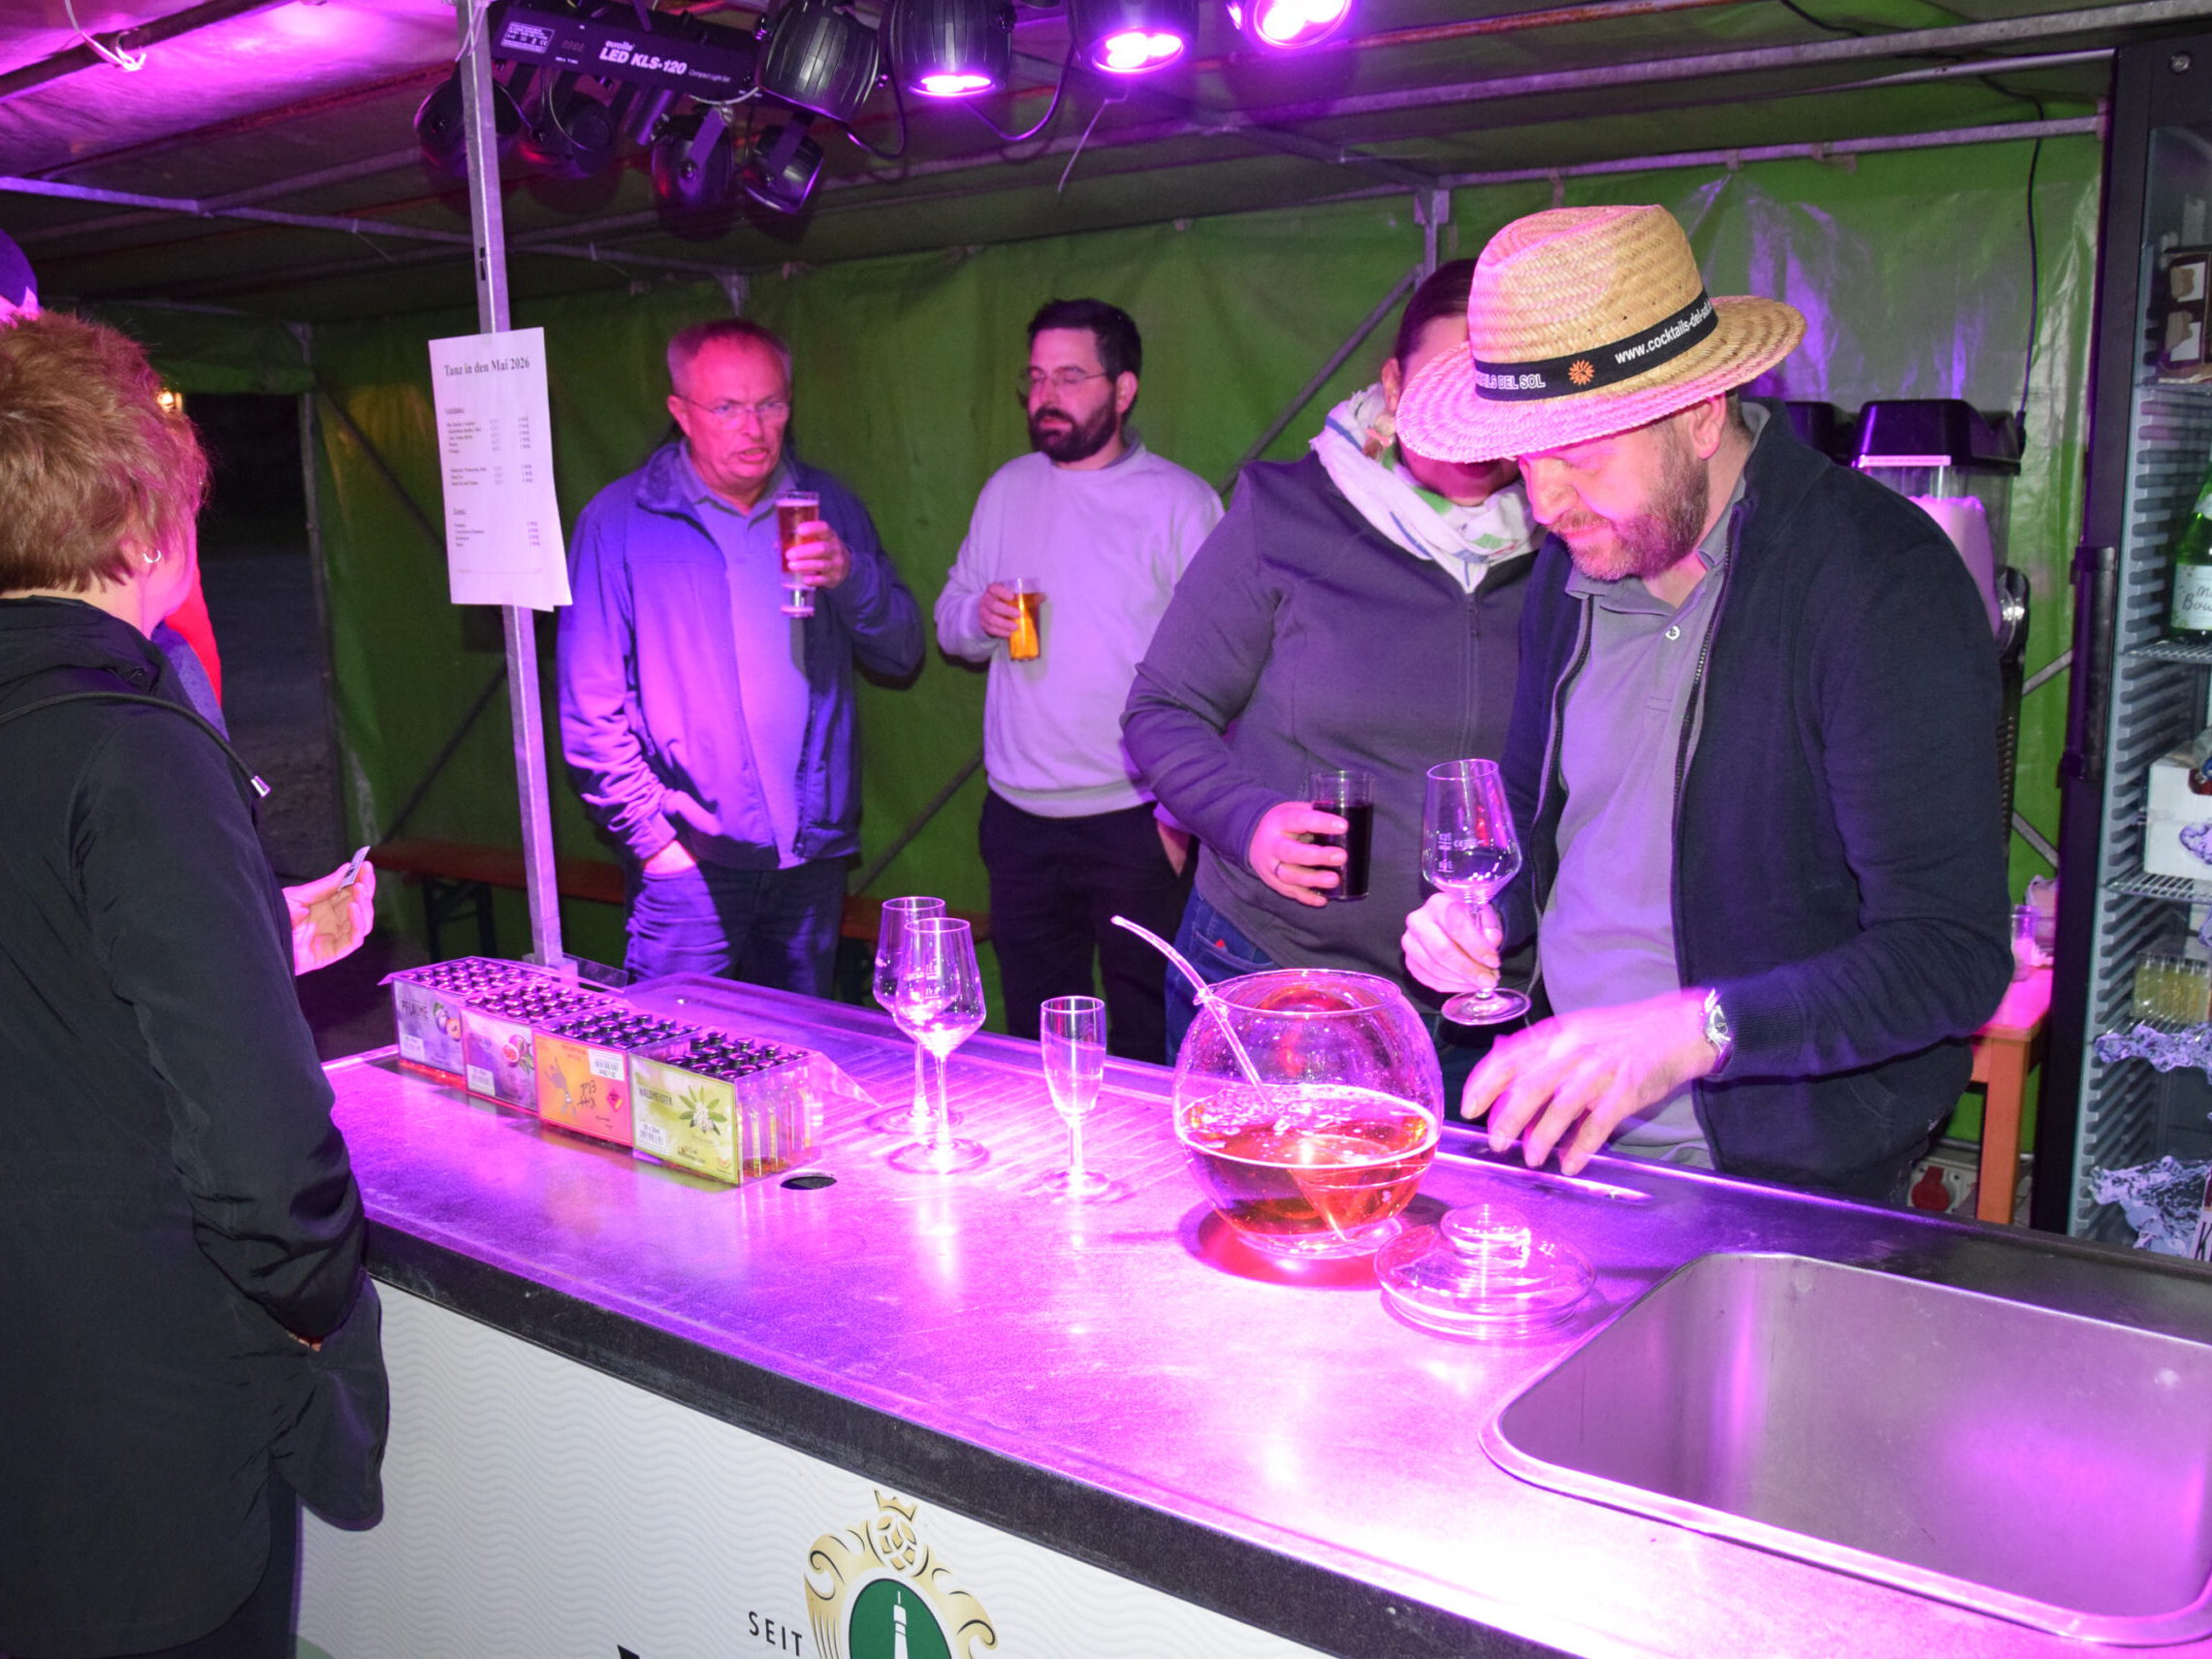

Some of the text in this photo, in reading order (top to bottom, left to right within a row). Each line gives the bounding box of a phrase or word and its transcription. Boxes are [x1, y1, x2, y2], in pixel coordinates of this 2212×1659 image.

[599, 48, 629, 64] LED
[630, 53, 688, 75] KLS-120
[443, 356, 530, 376] Tanz in den Mai 2026
[1519, 373, 1547, 390] SOL
[749, 1611, 803, 1657] SEIT
